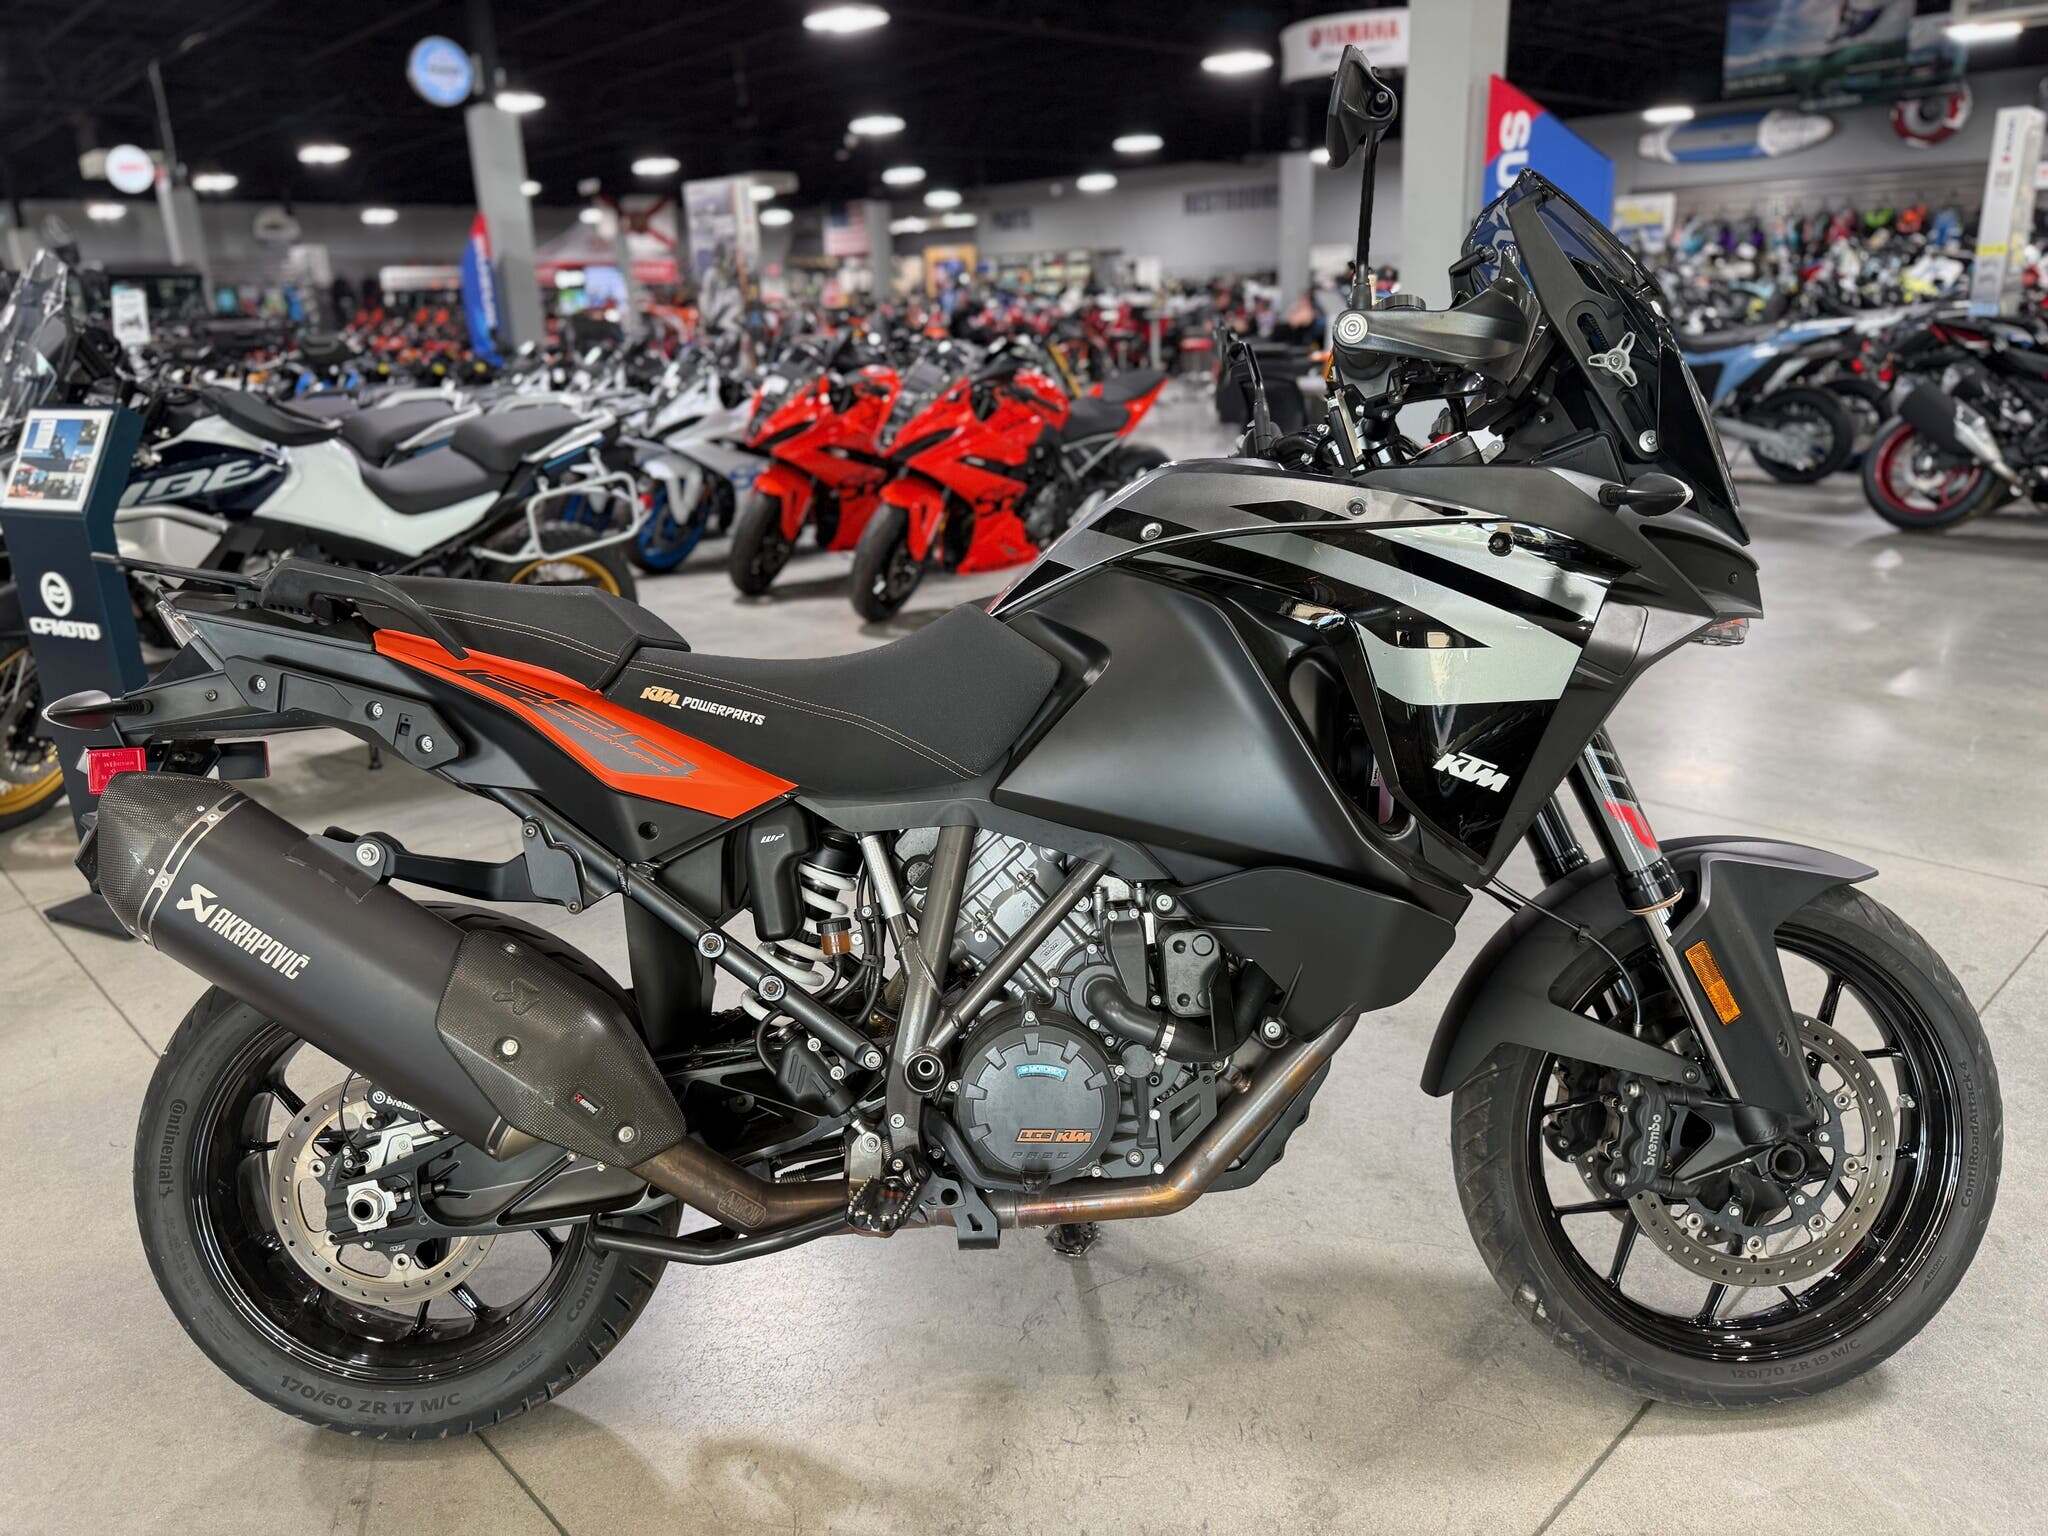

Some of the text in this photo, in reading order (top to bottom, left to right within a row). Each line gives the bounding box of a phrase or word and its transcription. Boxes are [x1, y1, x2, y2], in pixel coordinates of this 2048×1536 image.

[29, 616, 101, 641] CFMOTO
[639, 685, 766, 725] KTM POWERPARTS
[1432, 752, 1510, 793] KTM
[1055, 1129, 1092, 1143] KTM
[1642, 1113, 1662, 1166] brembo
[1790, 1361, 1810, 1374] ZR
[279, 1375, 463, 1415] 170/60 ZR 17 M/C
